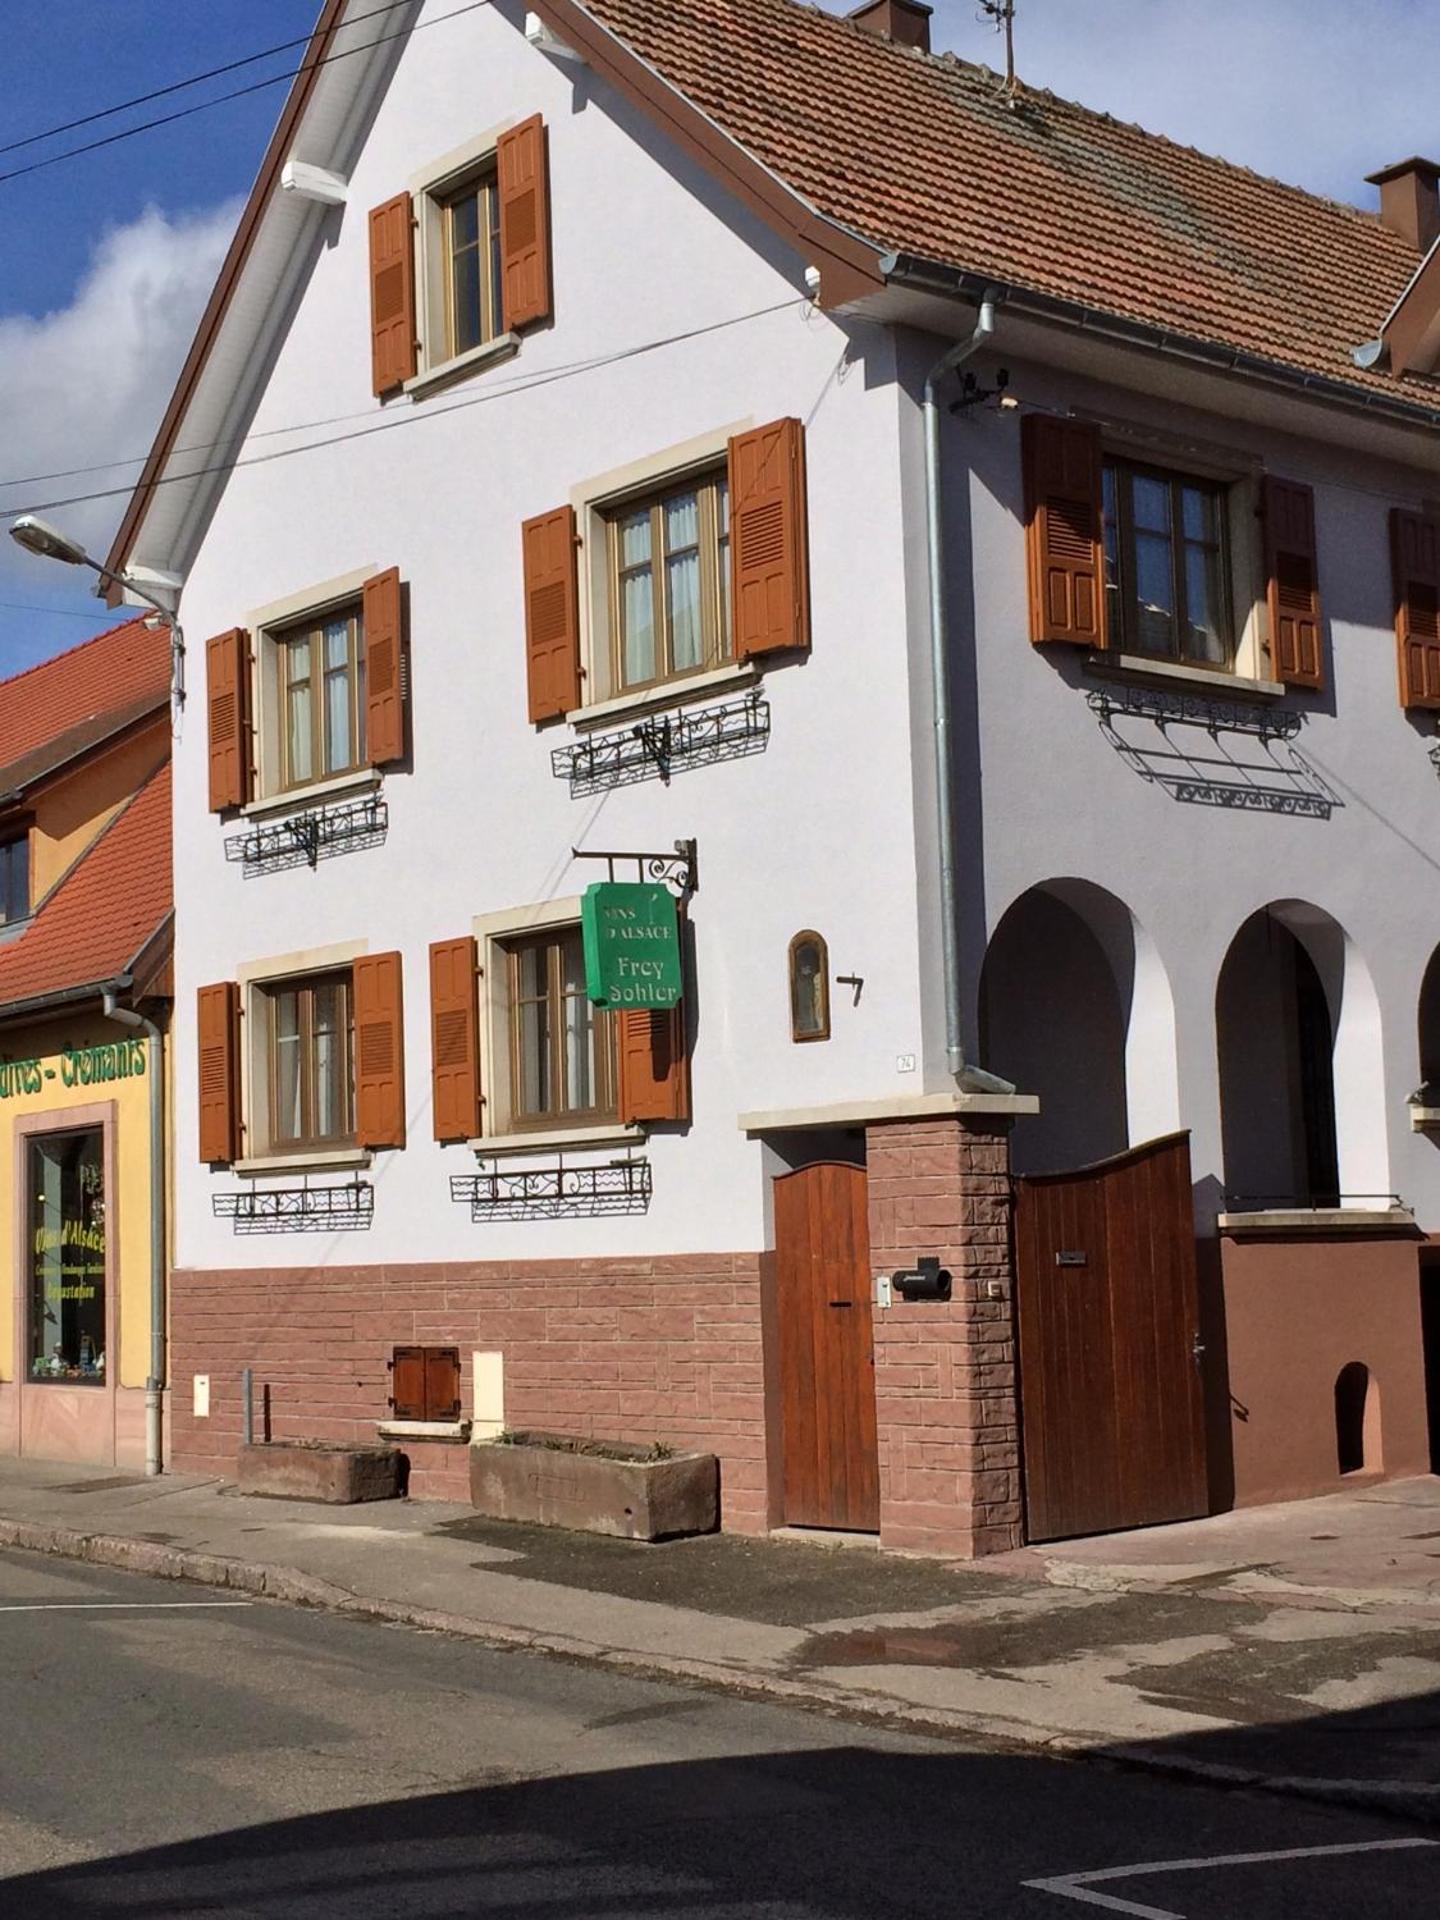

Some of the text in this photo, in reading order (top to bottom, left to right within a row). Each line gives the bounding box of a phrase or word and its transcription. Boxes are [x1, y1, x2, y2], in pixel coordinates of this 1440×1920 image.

[606, 926, 672, 939] DALSACE
[618, 957, 664, 980] Frey
[610, 983, 677, 1002] Sohler
